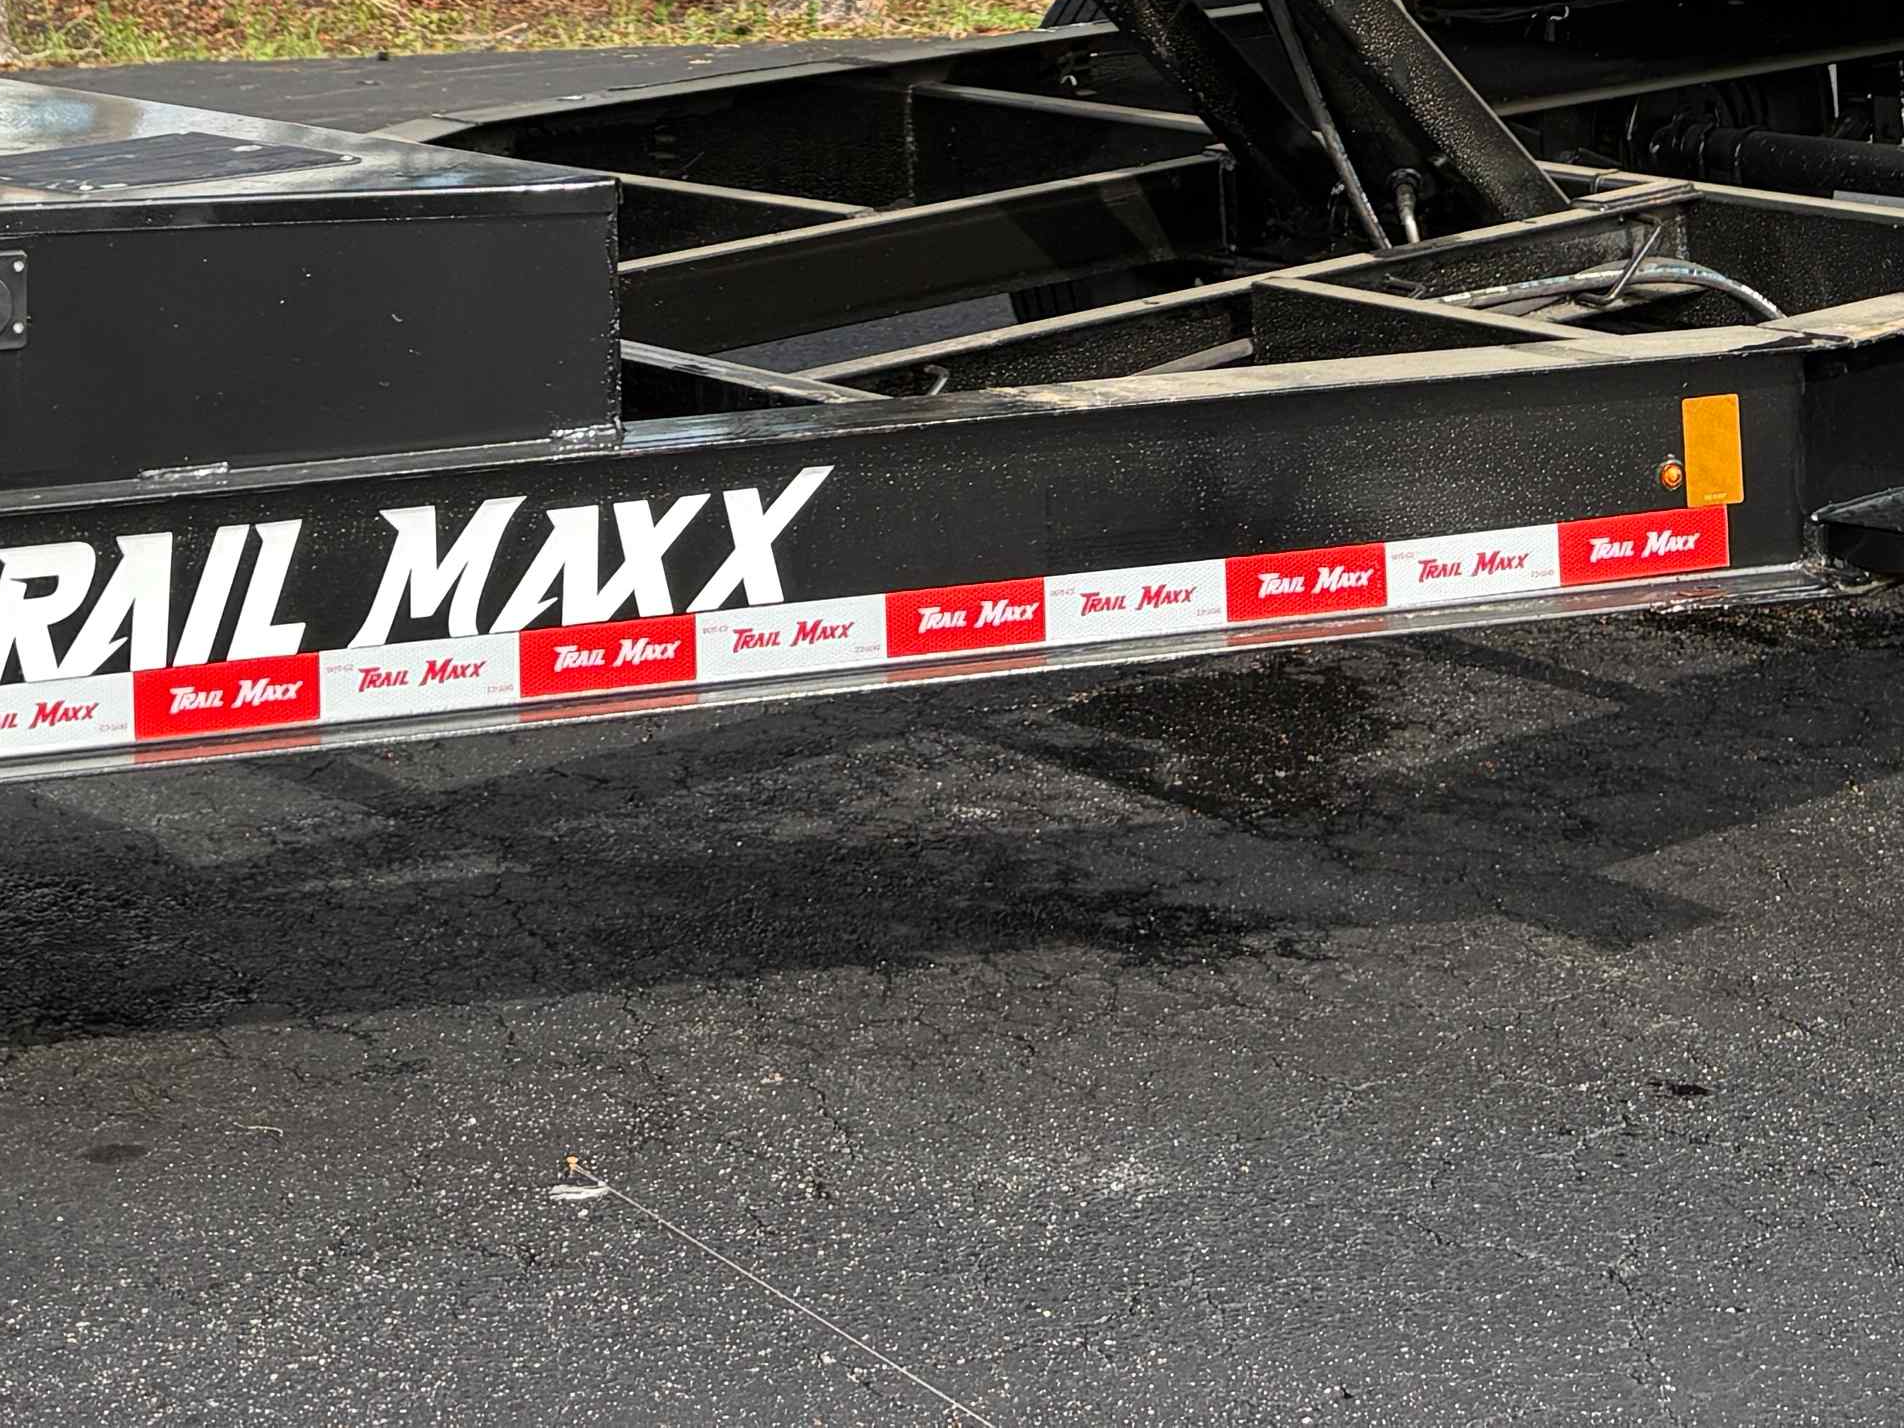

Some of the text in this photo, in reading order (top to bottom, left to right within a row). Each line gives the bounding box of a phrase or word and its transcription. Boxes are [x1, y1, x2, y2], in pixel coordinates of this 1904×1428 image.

[350, 466, 834, 649] MAXX
[1589, 529, 1700, 563] TRAIL MAXX
[1258, 566, 1375, 598] TRAIL MAXX
[1417, 550, 1532, 582] TRAIL MAXX
[917, 599, 1040, 633] TRAIL MAXX
[1080, 584, 1197, 616] TRAIL MAXX
[732, 619, 854, 653] TRAIL MAXX
[553, 638, 681, 672] TRAIL MAXX
[358, 658, 487, 692] TRAIL MAXX
[169, 678, 303, 714] TRAIL MAXX
[29, 701, 99, 729] MAXX
